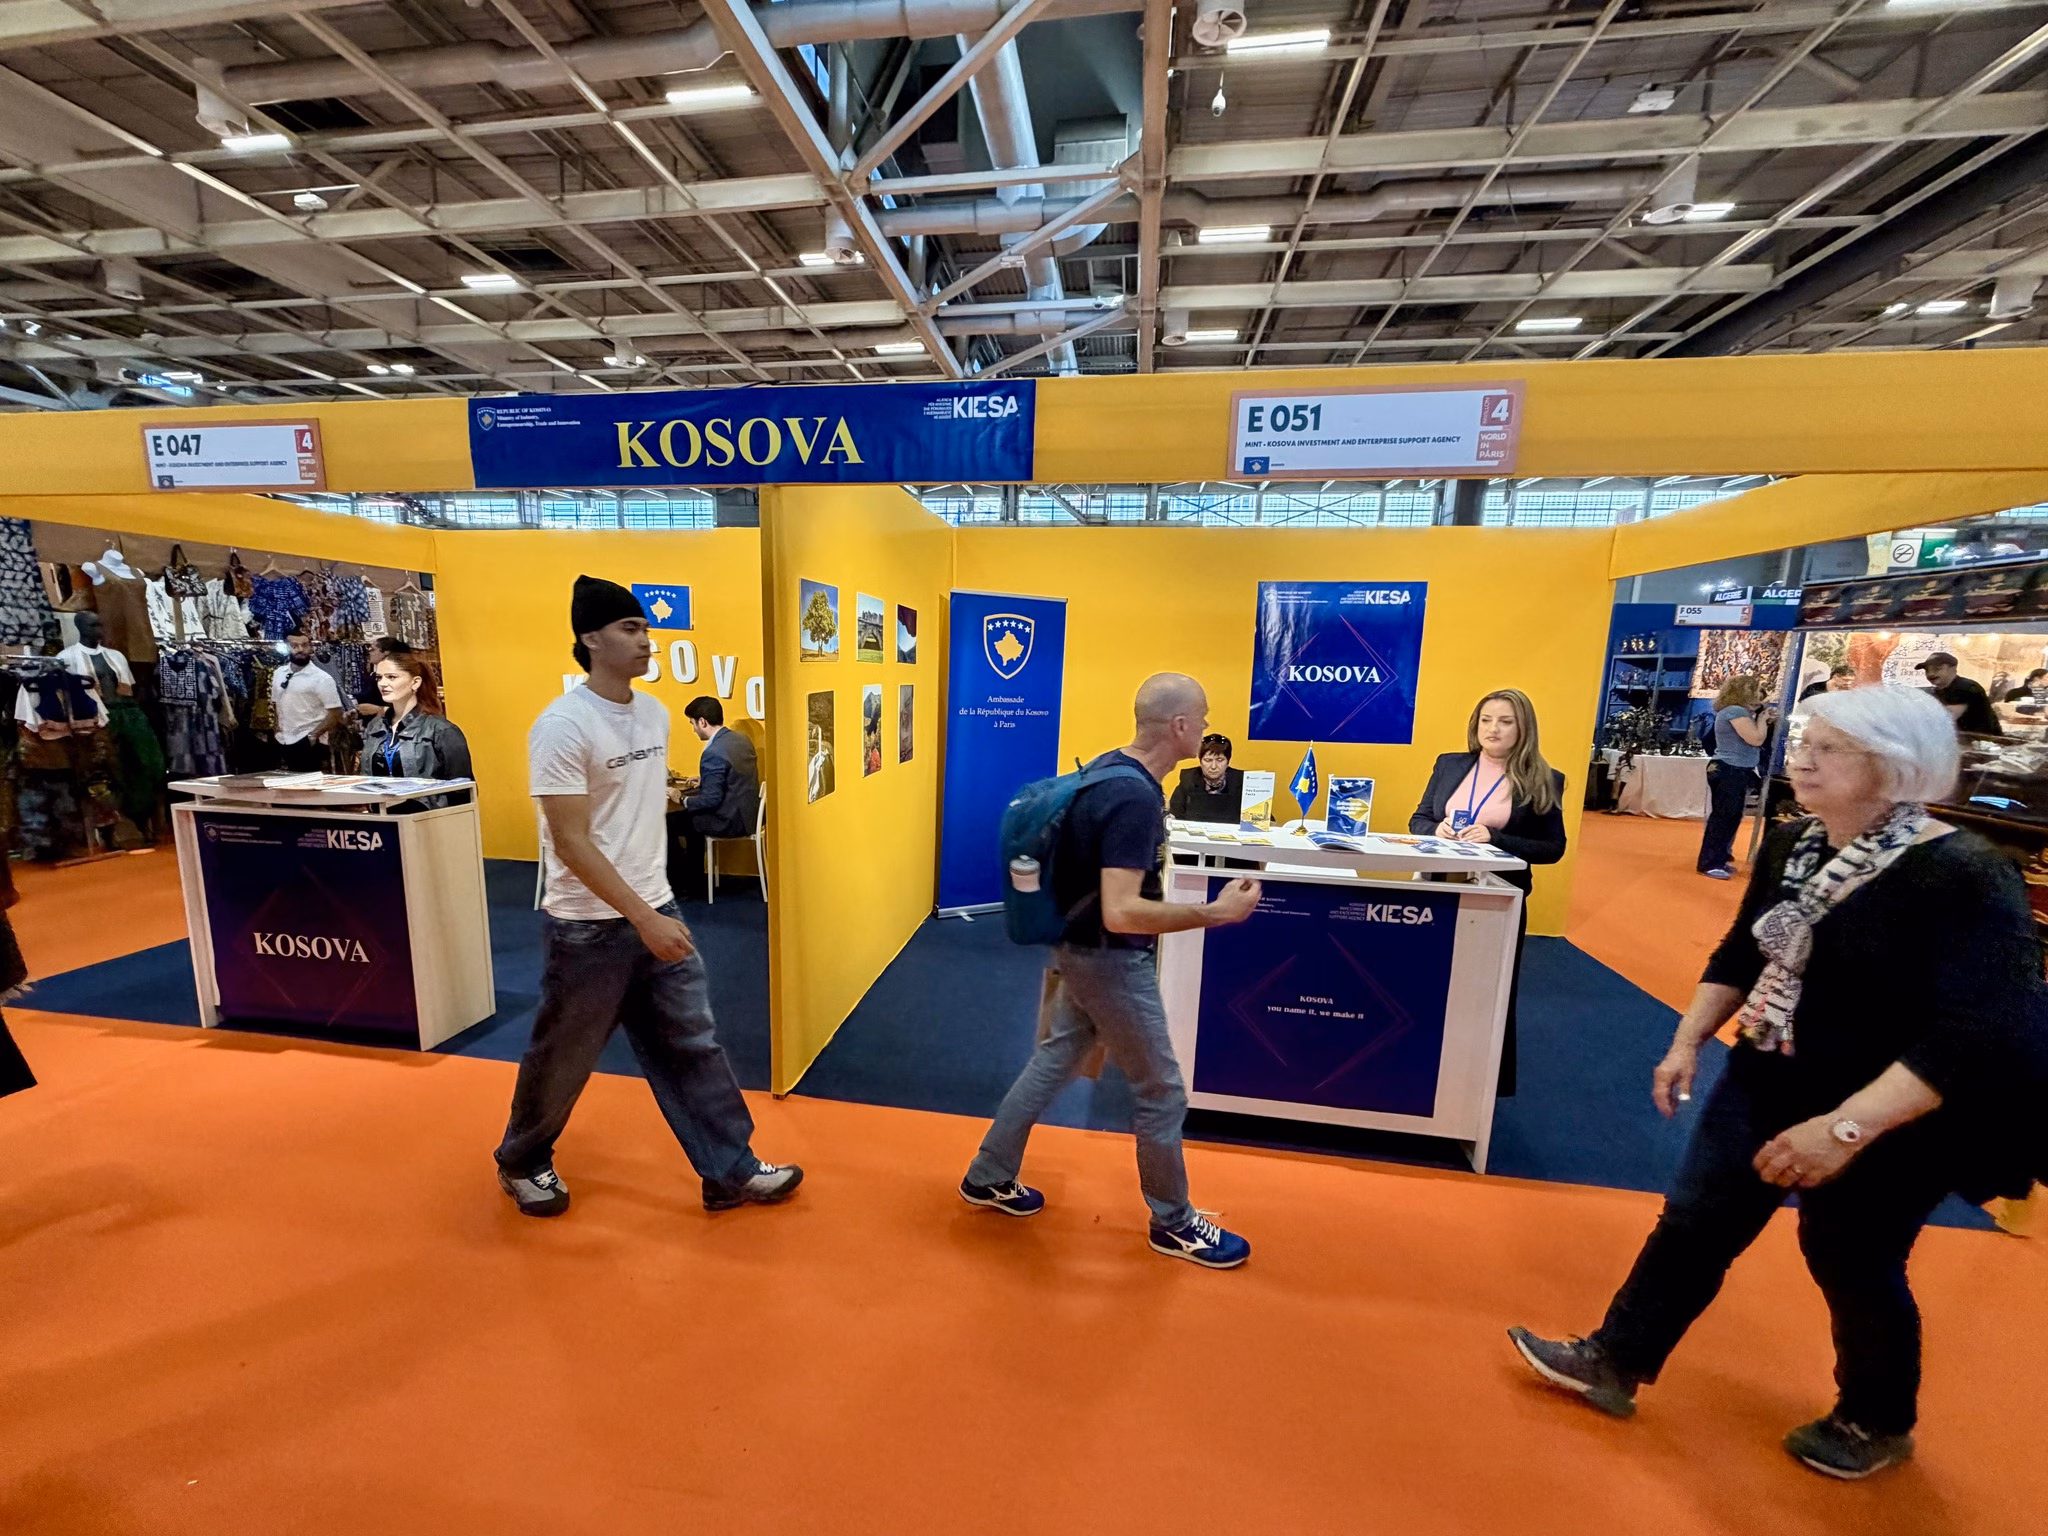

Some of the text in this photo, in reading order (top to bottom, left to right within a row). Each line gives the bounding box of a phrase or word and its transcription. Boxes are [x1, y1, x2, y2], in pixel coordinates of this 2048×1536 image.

[953, 395, 1018, 418] KIESA
[1491, 398, 1509, 422] 4
[1248, 403, 1322, 432] E 051
[152, 434, 201, 456] E 047
[302, 432, 313, 450] 4
[614, 416, 865, 469] KOSOVA
[1480, 432, 1507, 441] WORLD
[1365, 590, 1411, 605] KIESA
[1714, 590, 1743, 601] ALGERIE
[1287, 665, 1381, 683] KOSOVA
[977, 708, 1014, 717] République
[326, 829, 383, 851] KIESA
[1366, 904, 1433, 925] KIESA
[253, 932, 370, 963] KOSOVA
[1300, 995, 1333, 1004] KOSOVA
[1333, 1011, 1355, 1019] make
